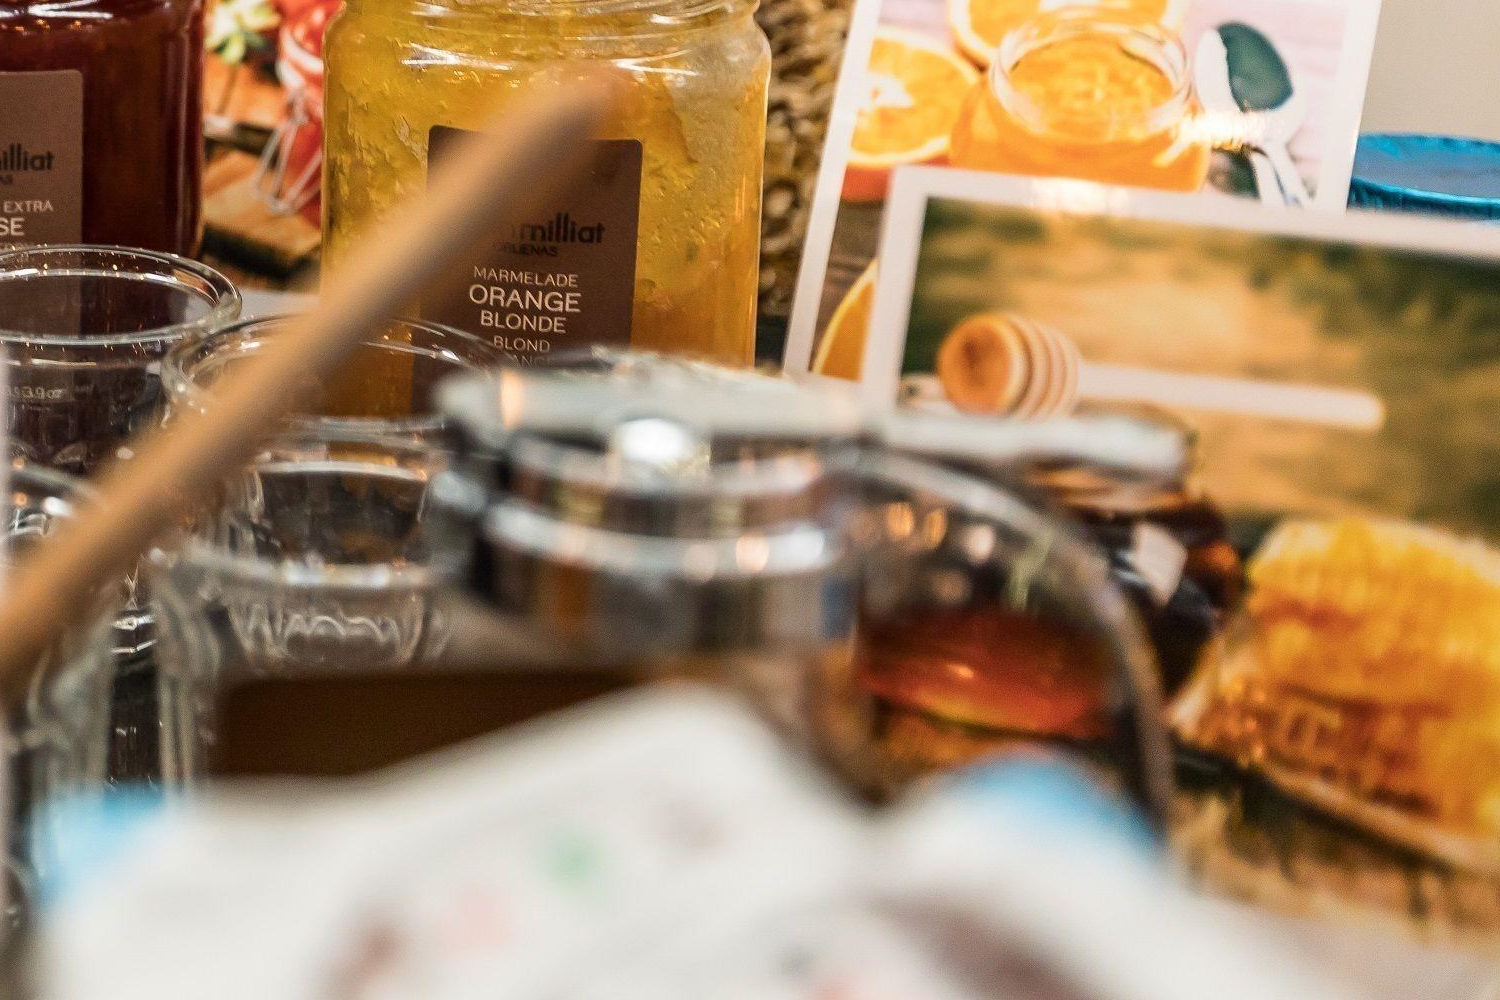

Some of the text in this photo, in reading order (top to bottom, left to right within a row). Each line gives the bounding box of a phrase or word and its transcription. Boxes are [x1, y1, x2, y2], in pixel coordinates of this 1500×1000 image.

[3, 199, 54, 213] EXTRA
[473, 265, 580, 288] MARMELADE
[469, 284, 582, 313] ORANGE
[480, 309, 567, 334] BLONDE
[493, 335, 551, 353] BLOND
